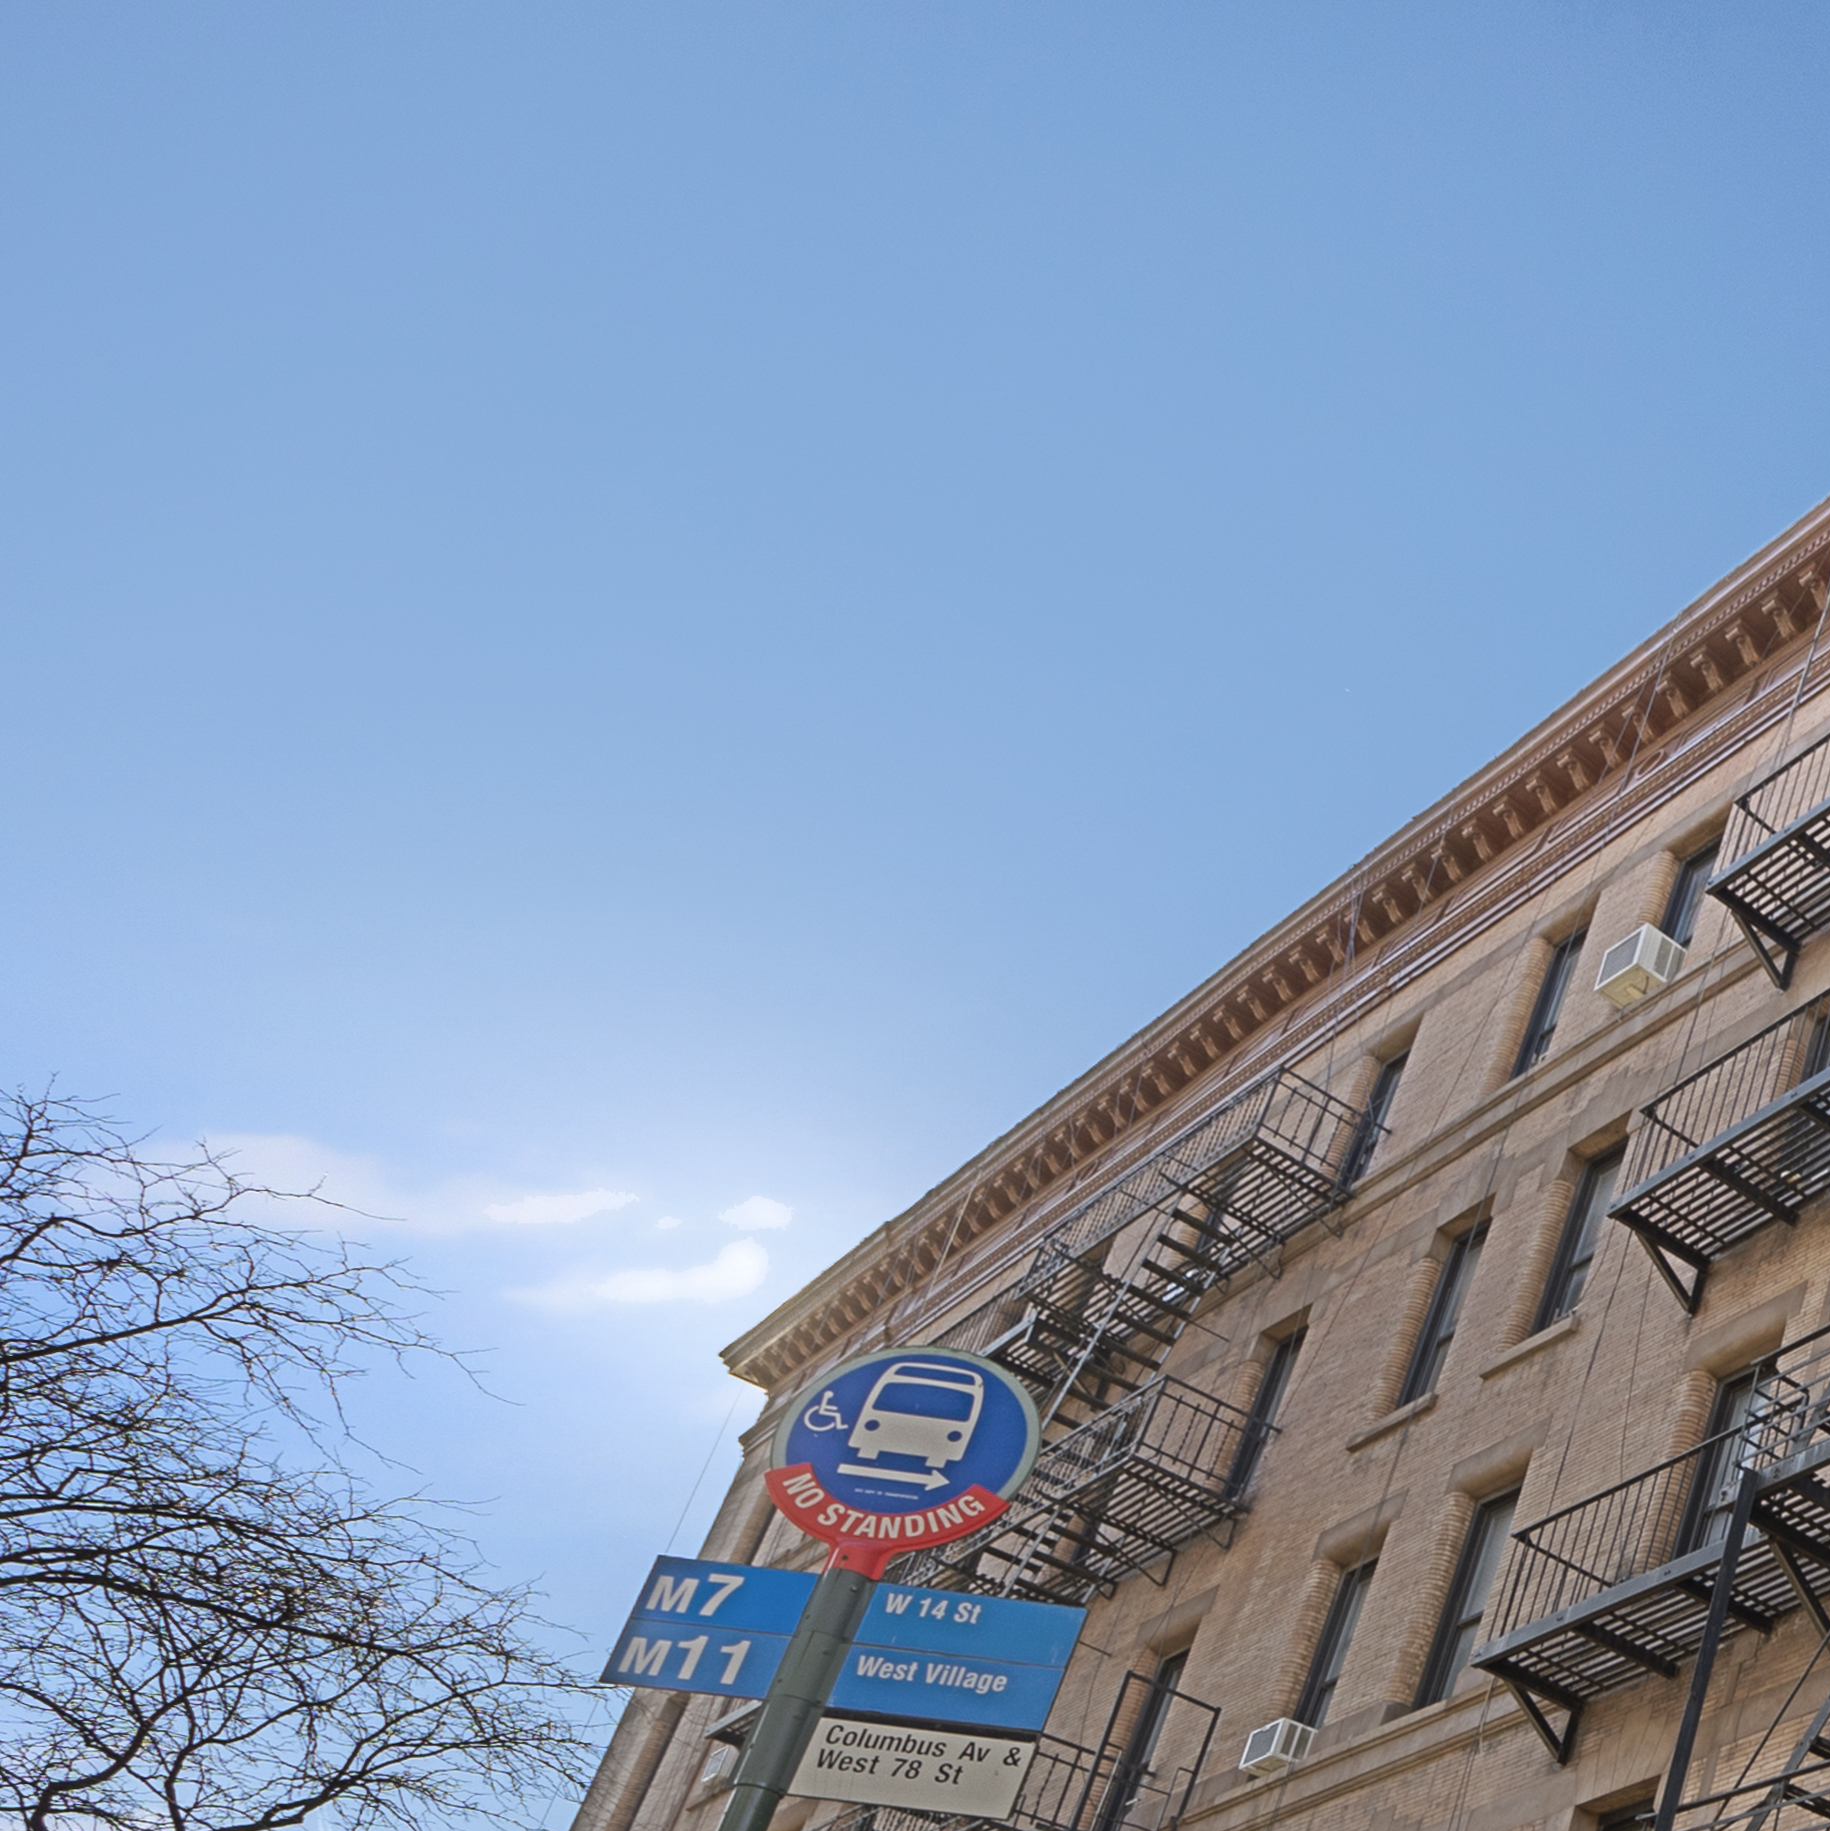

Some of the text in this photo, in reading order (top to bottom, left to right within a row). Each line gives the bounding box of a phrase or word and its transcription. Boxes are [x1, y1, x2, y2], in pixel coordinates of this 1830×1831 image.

[782, 1472, 985, 1539] NO STANDING
[646, 1573, 744, 1617] M7
[885, 1594, 982, 1625] W 14 St
[618, 1635, 752, 1685] M11
[856, 1655, 1008, 1694] West Village
[816, 1748, 964, 1784] West 78 St
[826, 1725, 1021, 1767] Columbus Av &
